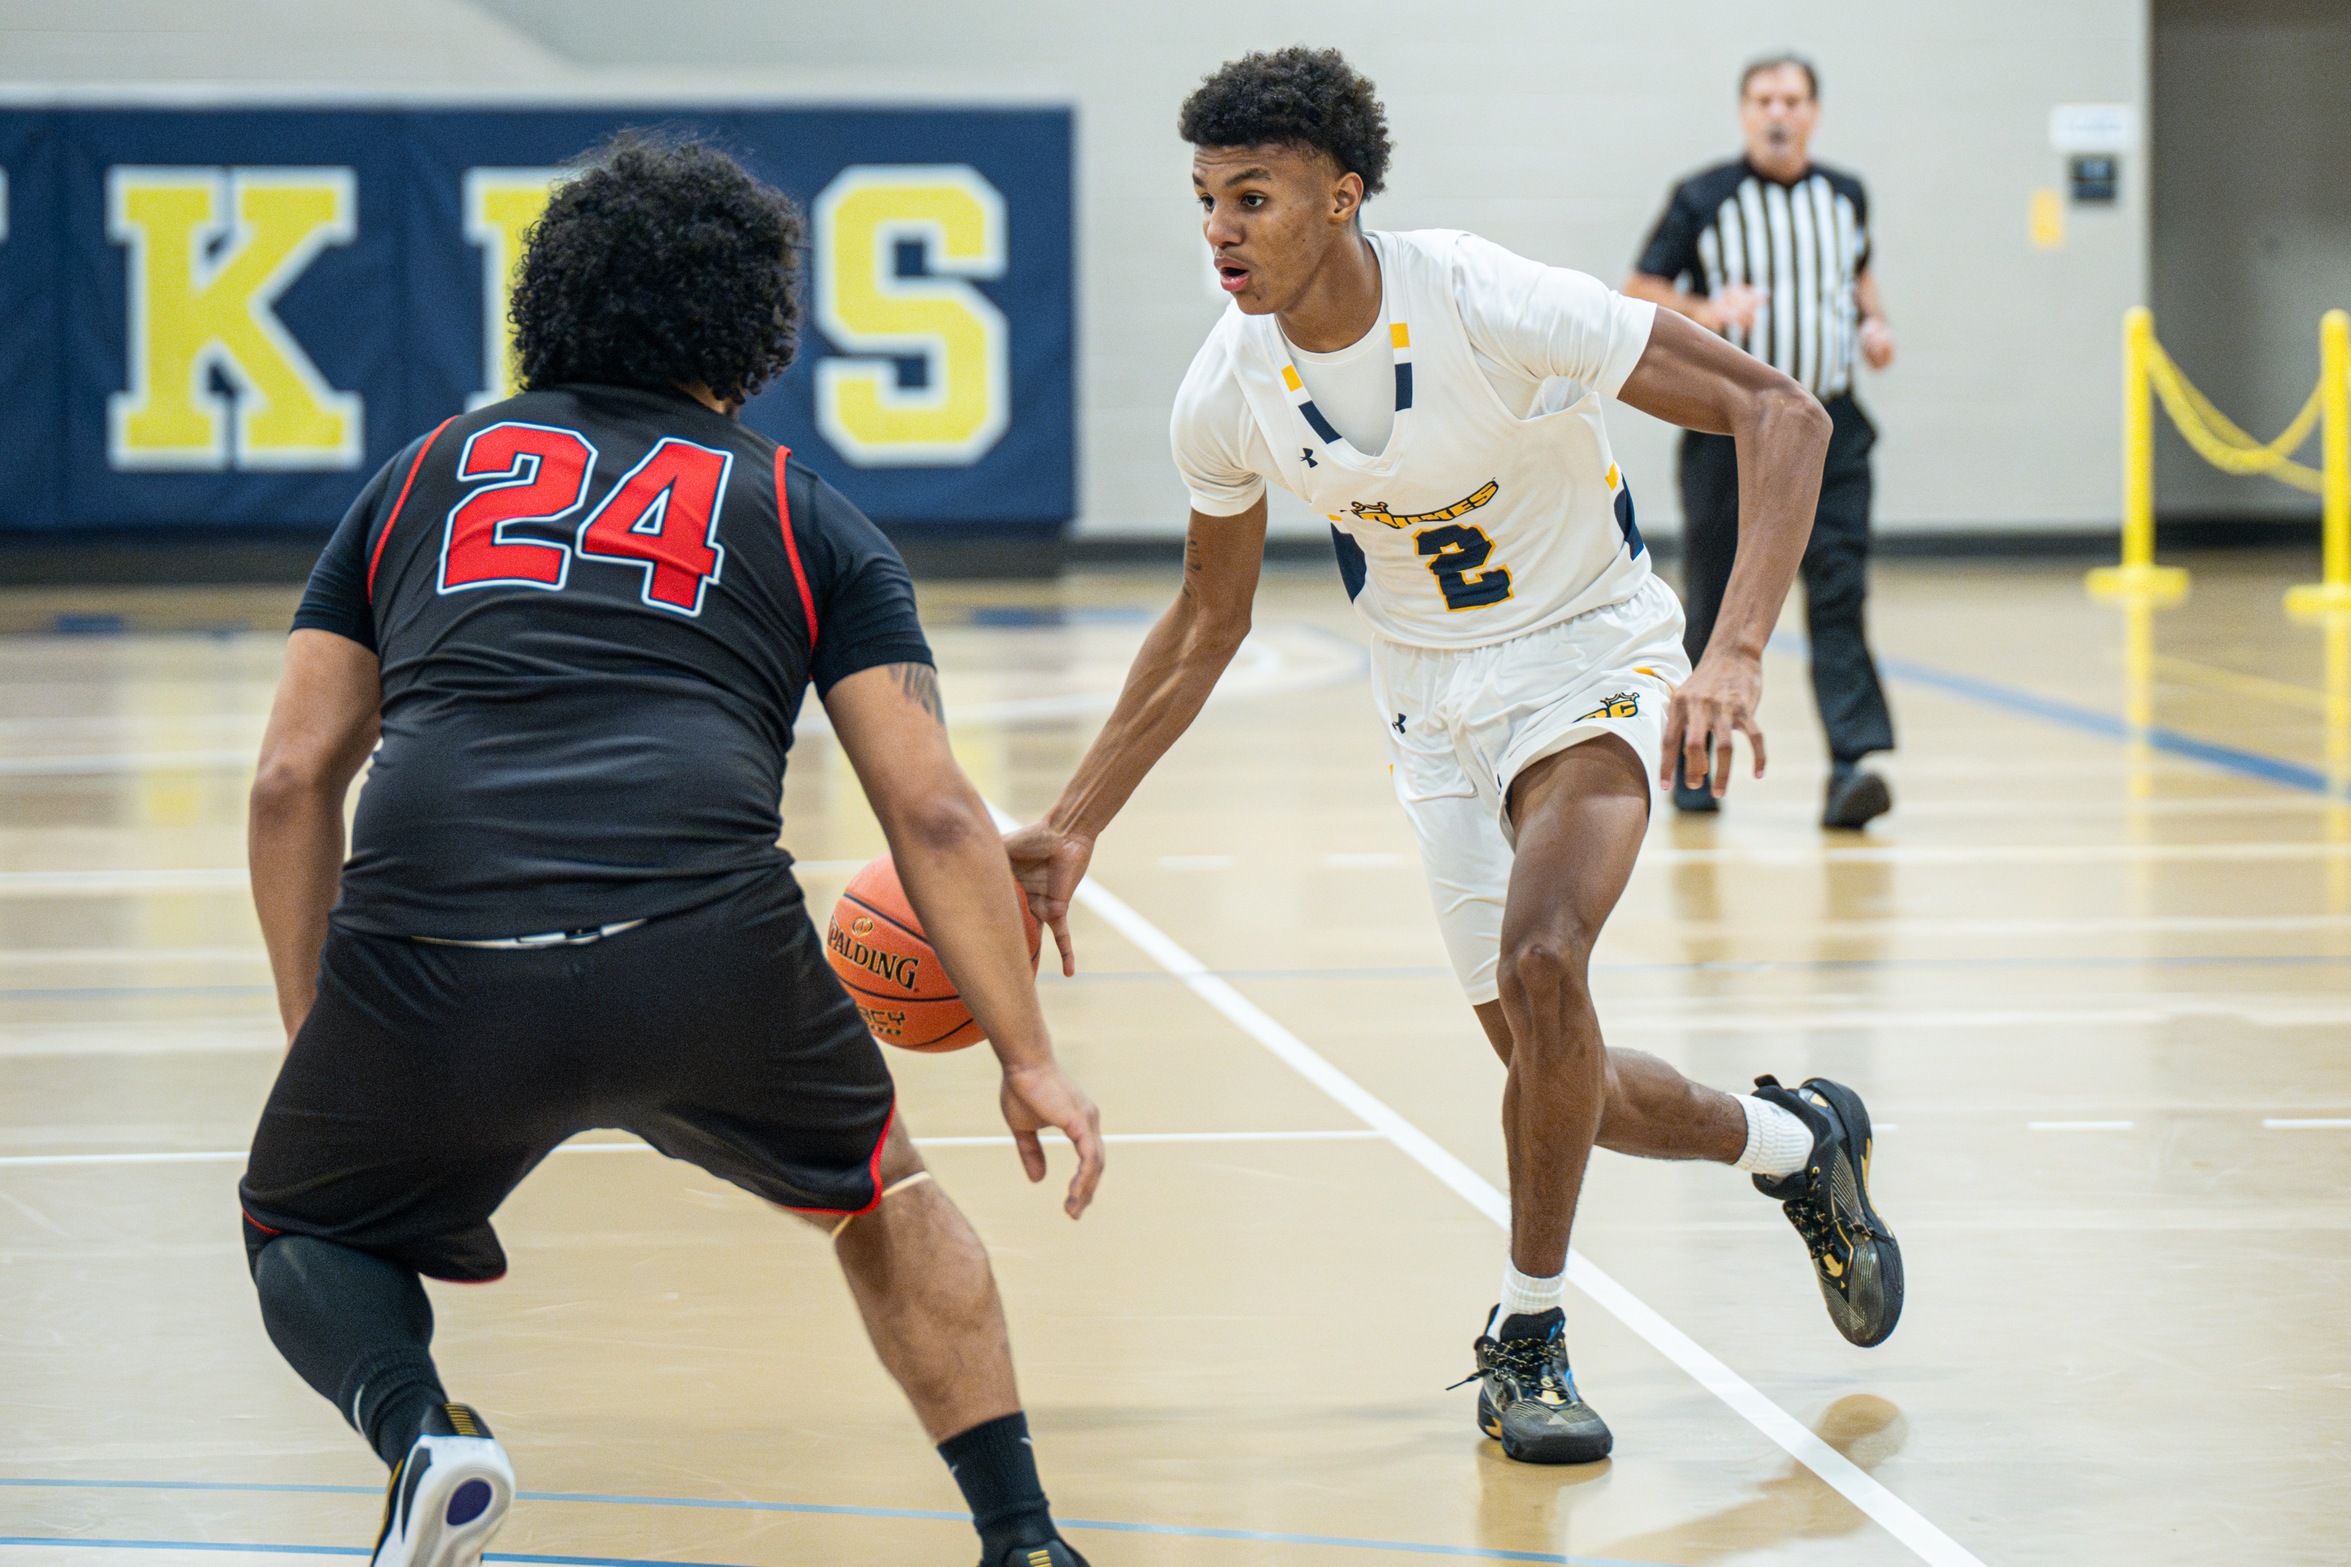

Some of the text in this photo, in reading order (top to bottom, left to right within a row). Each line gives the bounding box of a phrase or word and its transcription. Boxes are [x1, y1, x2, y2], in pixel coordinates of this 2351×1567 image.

[437, 422, 733, 618] 24
[1411, 523, 1515, 612] 2
[827, 916, 920, 991] PALDING
